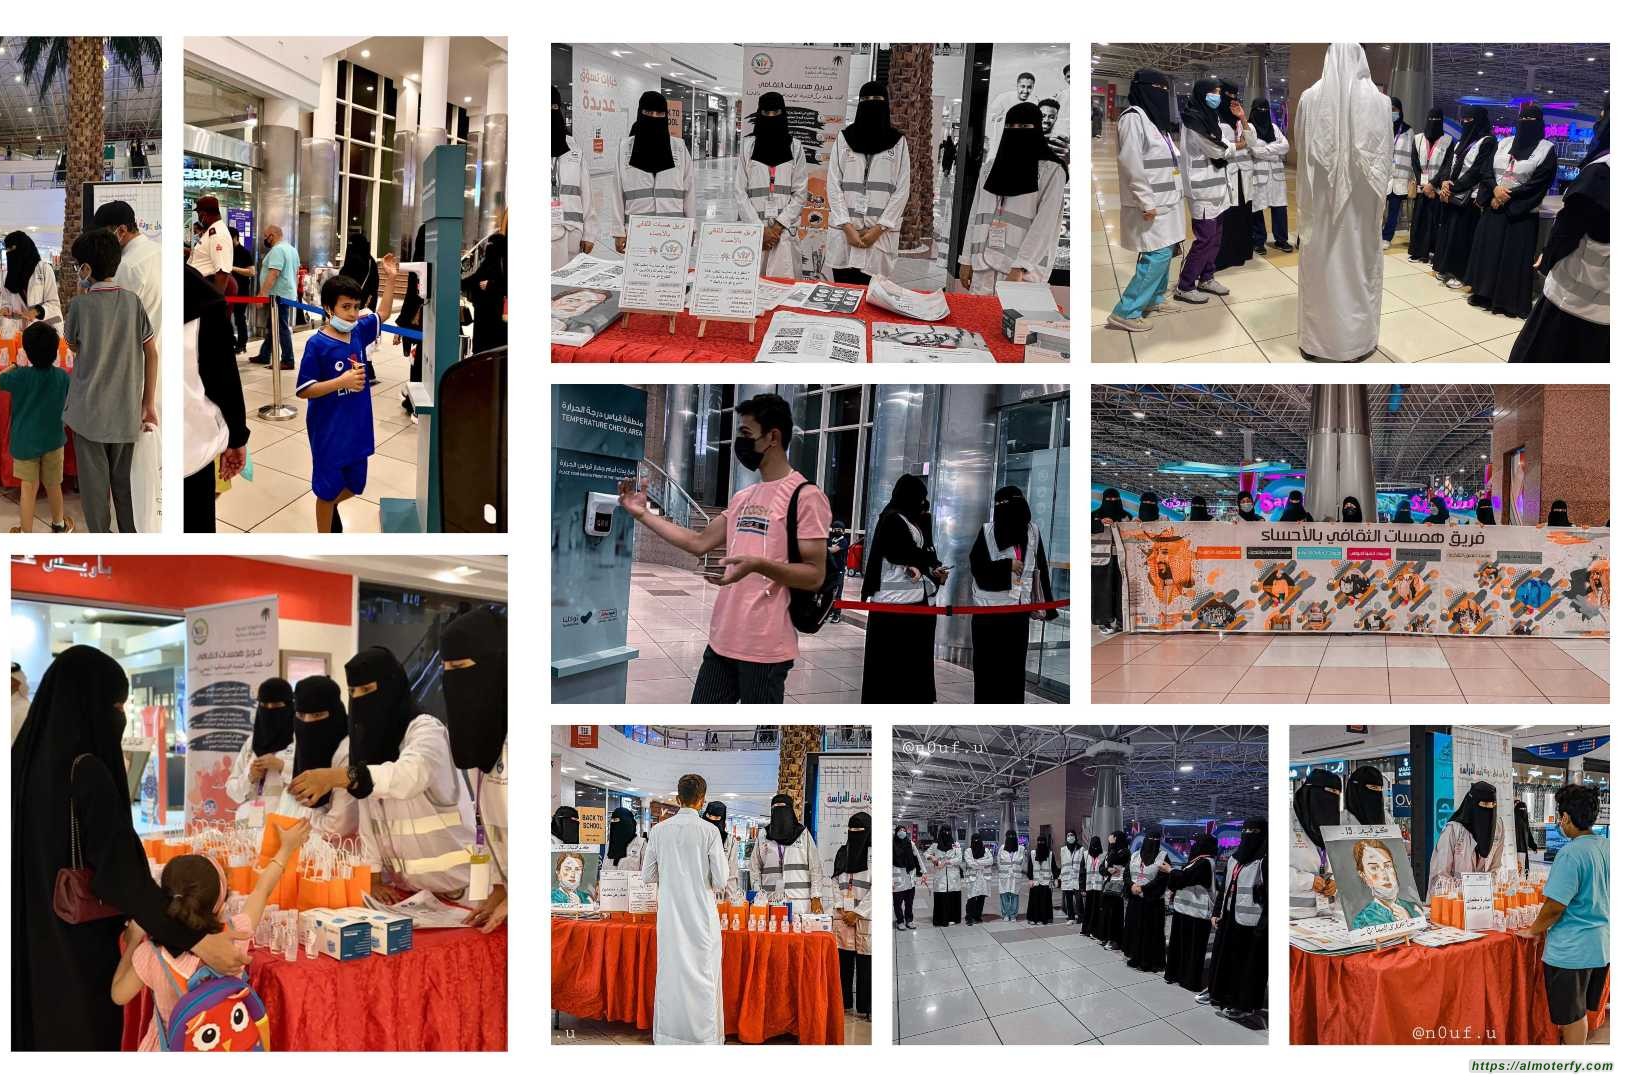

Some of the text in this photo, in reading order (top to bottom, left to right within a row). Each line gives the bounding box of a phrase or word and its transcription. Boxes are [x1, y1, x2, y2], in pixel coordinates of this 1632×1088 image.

[758, 81, 833, 91] فريق همسات الثقافي
[561, 401, 644, 428] منطقة قياس درجة الحرارة
[561, 413, 643, 437] TEMPERATURE CHECK AREA
[1261, 527, 1485, 548] فريق همسات الثقافي بالأحساء
[582, 822, 603, 830] SCHOOL
